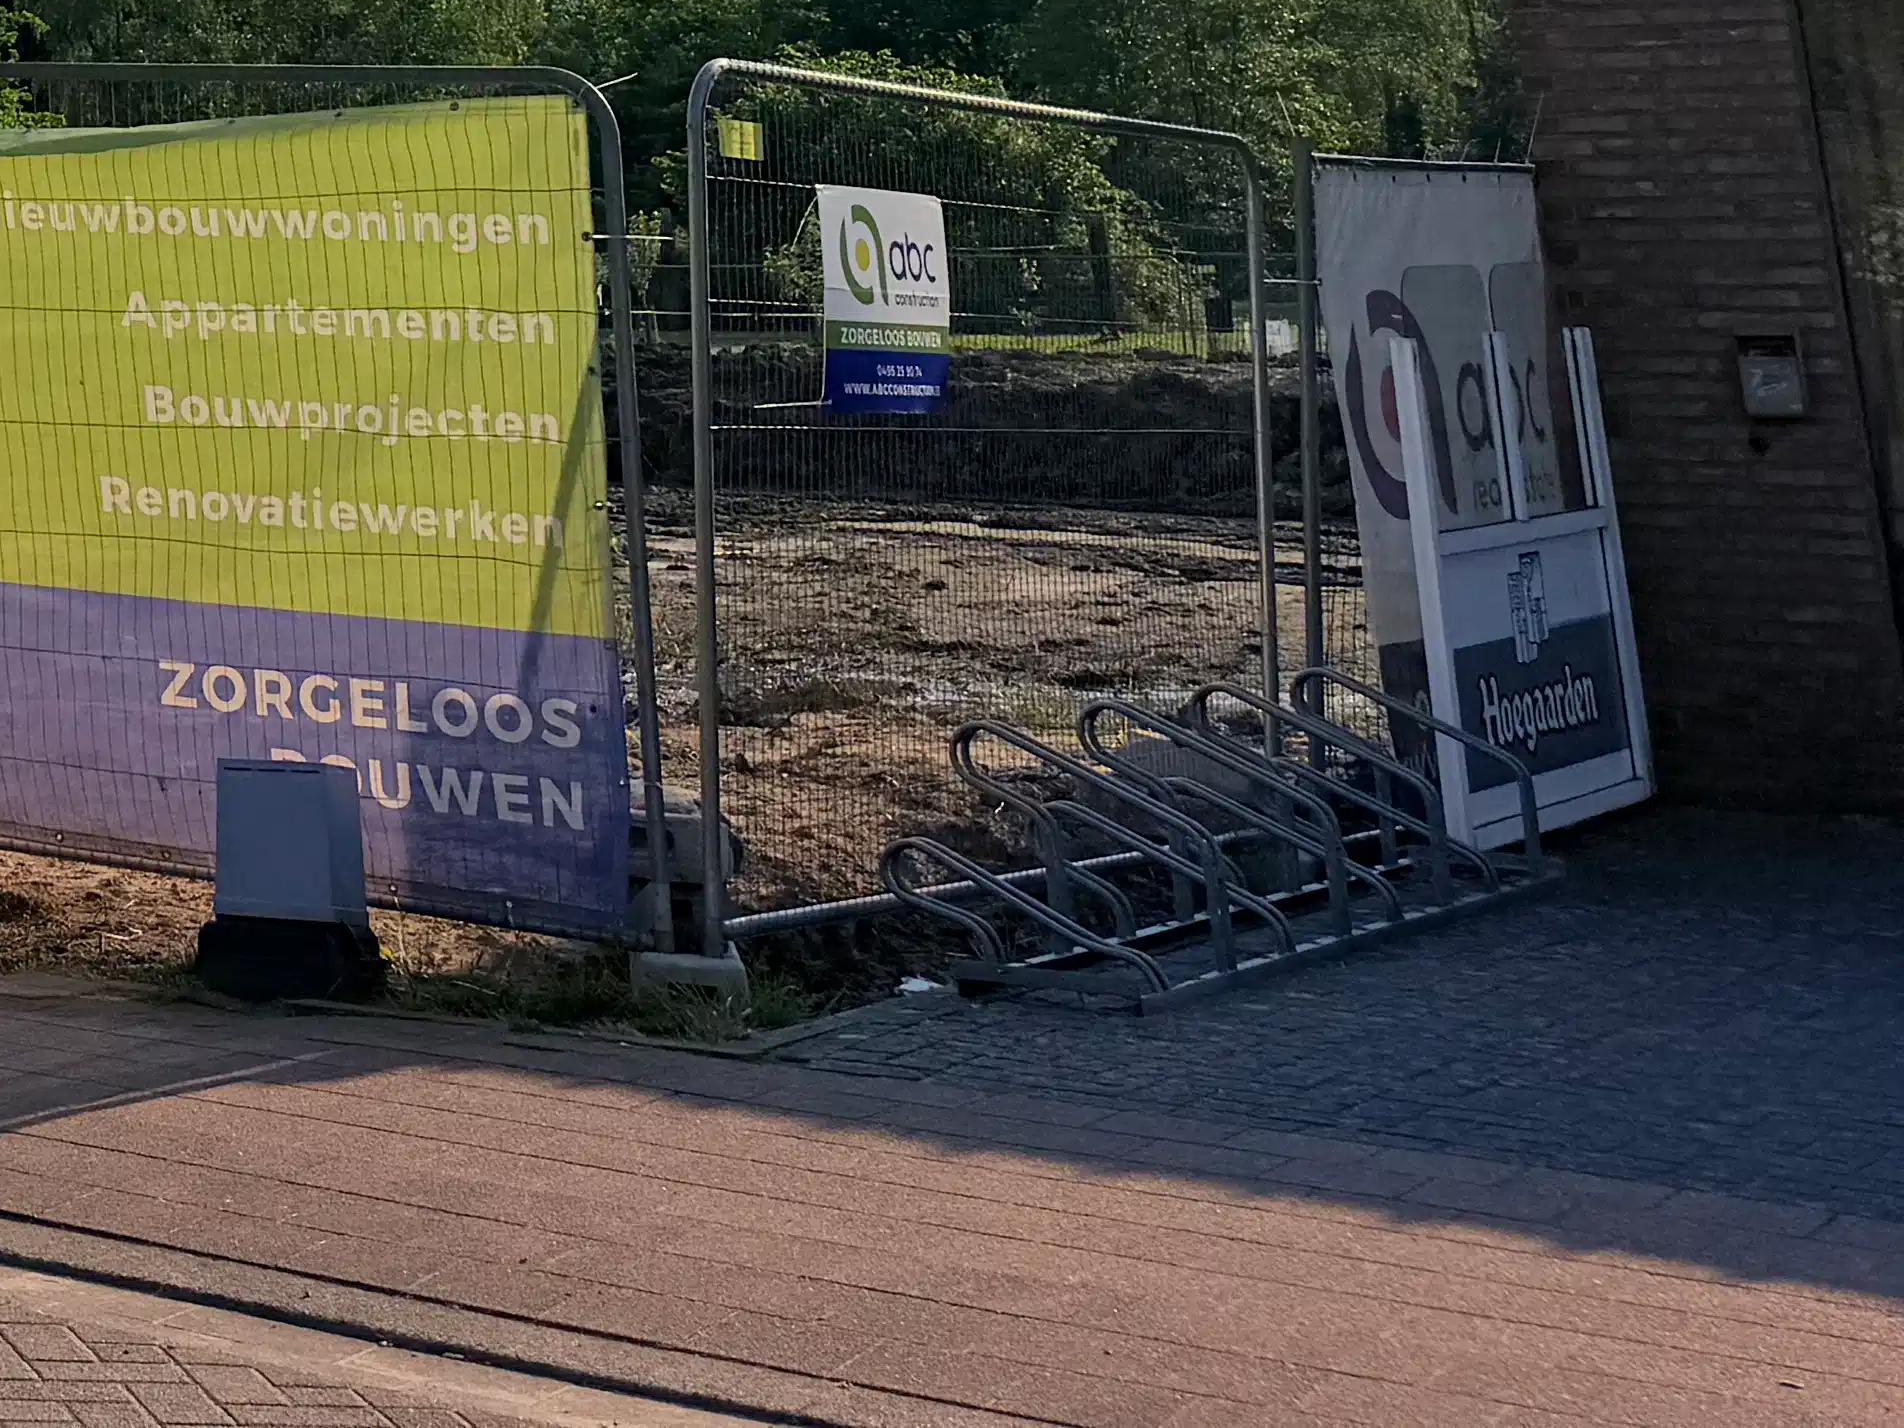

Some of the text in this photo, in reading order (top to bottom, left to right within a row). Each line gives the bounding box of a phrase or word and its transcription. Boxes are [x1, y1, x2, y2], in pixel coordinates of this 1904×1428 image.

[889, 232, 936, 283] abc
[121, 291, 556, 345] Appartementen
[895, 291, 939, 308] construction
[841, 327, 906, 346] ZORGELOOS
[144, 384, 559, 446] Bouwprojecten
[99, 475, 565, 547] Renovatiewerken
[159, 660, 582, 748] ZORGELOOS
[1479, 664, 1599, 752] Hoegaarden
[270, 748, 585, 831] UWEN
